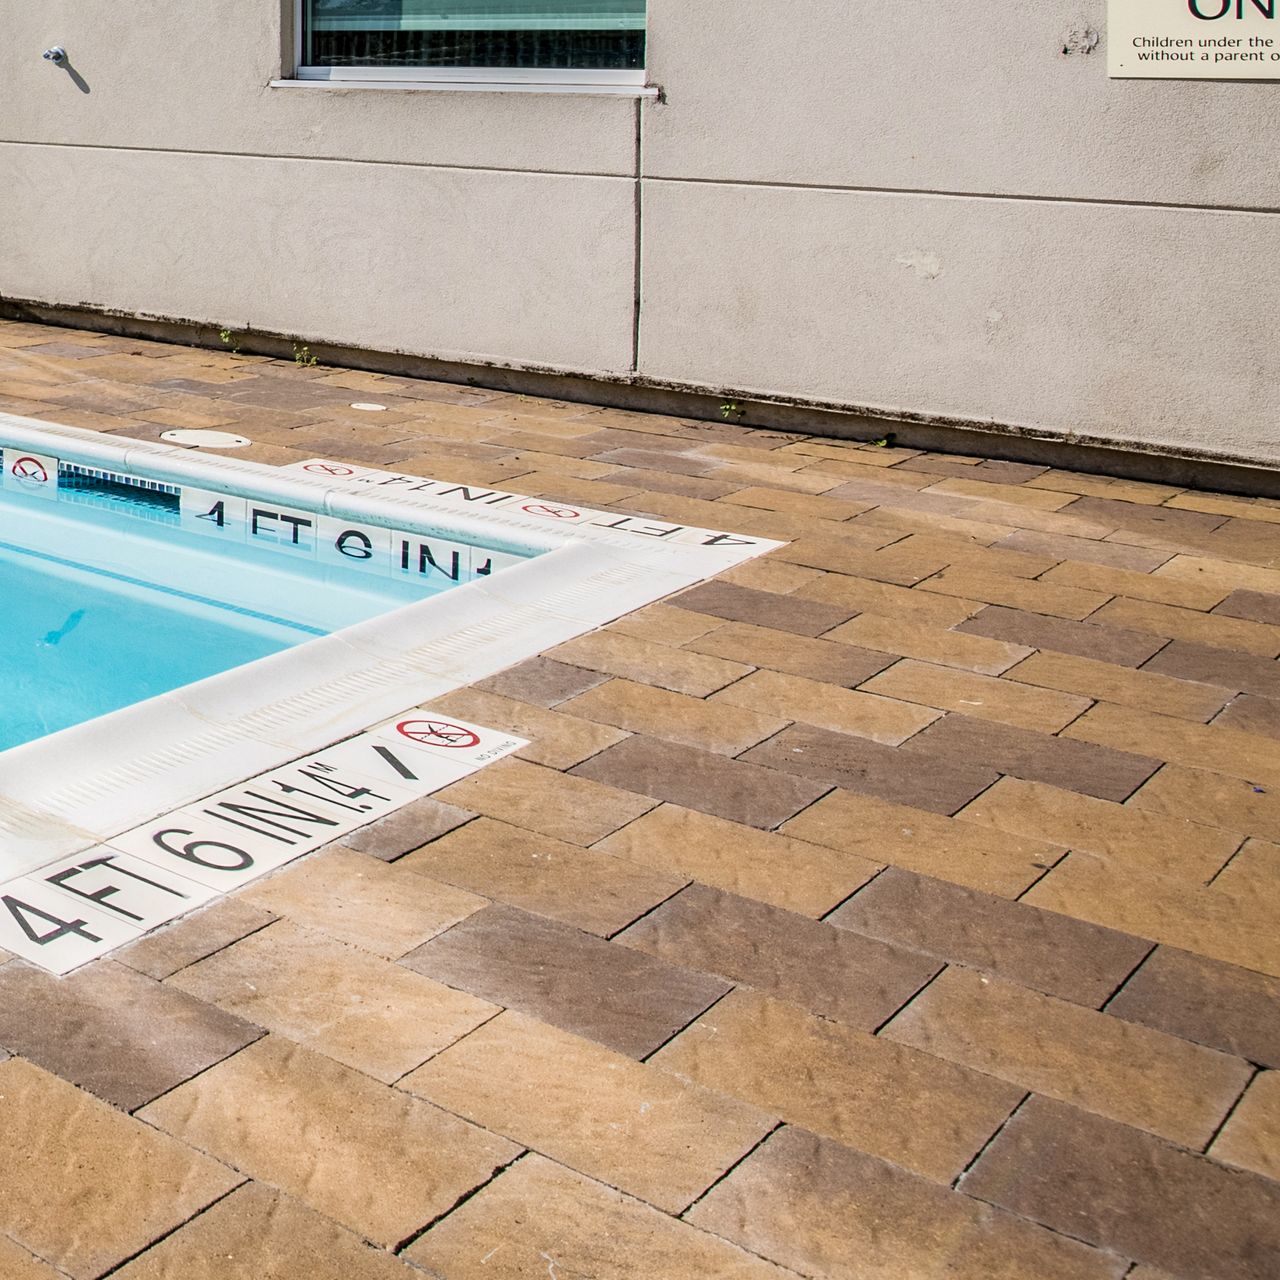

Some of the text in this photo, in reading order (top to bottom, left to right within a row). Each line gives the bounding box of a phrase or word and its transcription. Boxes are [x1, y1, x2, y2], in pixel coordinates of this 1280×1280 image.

[1132, 37, 1274, 48] Children under the
[1137, 50, 1196, 62] without
[1200, 53, 1210, 62] a
[1214, 51, 1265, 64] parent
[591, 517, 685, 537] FT
[203, 790, 340, 846] IN
[152, 828, 254, 873] 6
[44, 854, 194, 922] FT
[1, 895, 104, 947] 4
